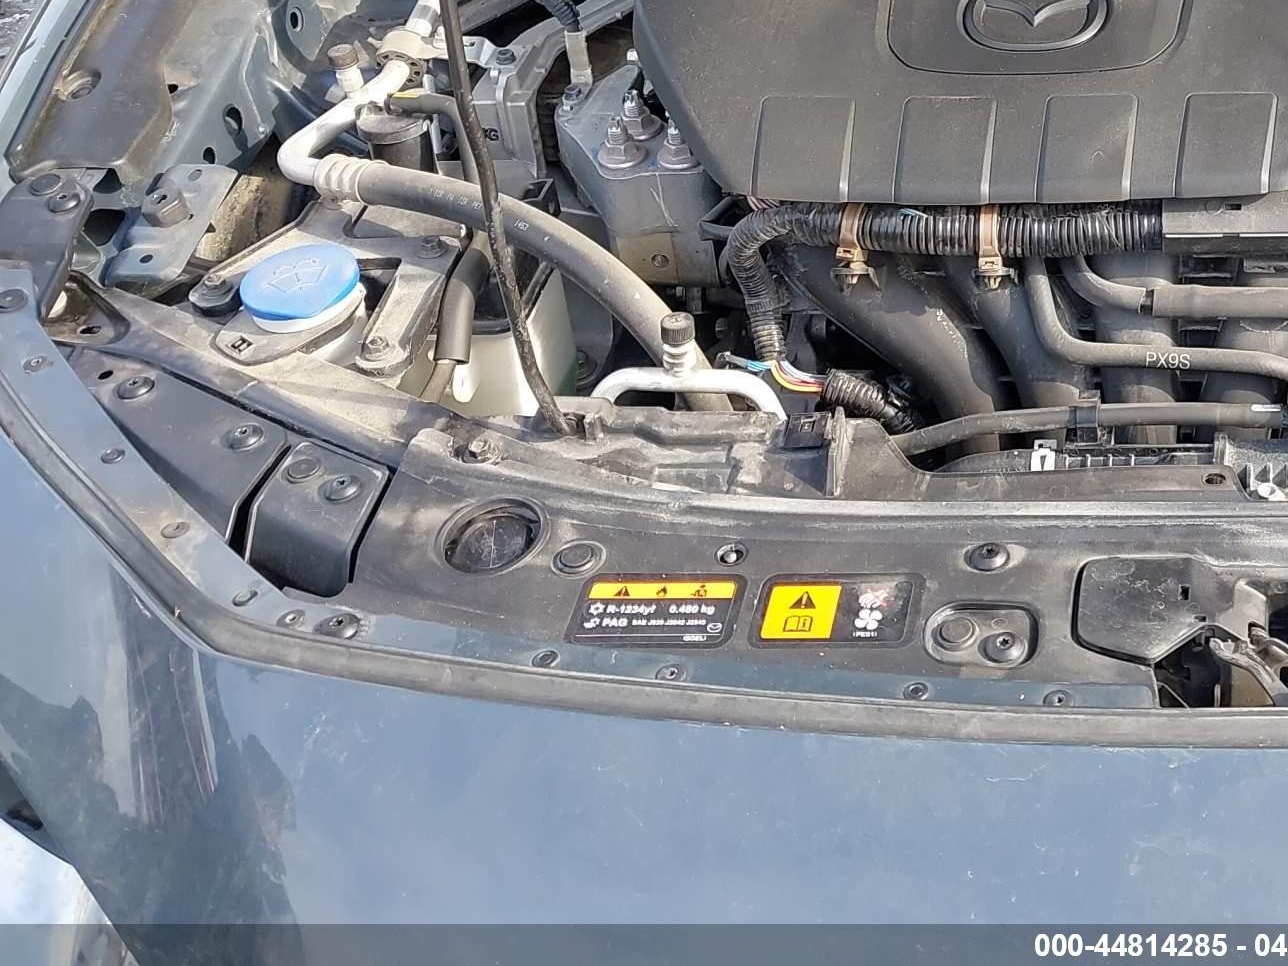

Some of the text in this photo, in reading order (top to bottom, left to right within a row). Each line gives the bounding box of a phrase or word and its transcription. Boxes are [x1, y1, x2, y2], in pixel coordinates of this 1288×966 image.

[1145, 351, 1190, 370] PX9S
[606, 604, 657, 615] R-1234yf
[701, 603, 716, 615] kg
[602, 617, 627, 627] PAG
